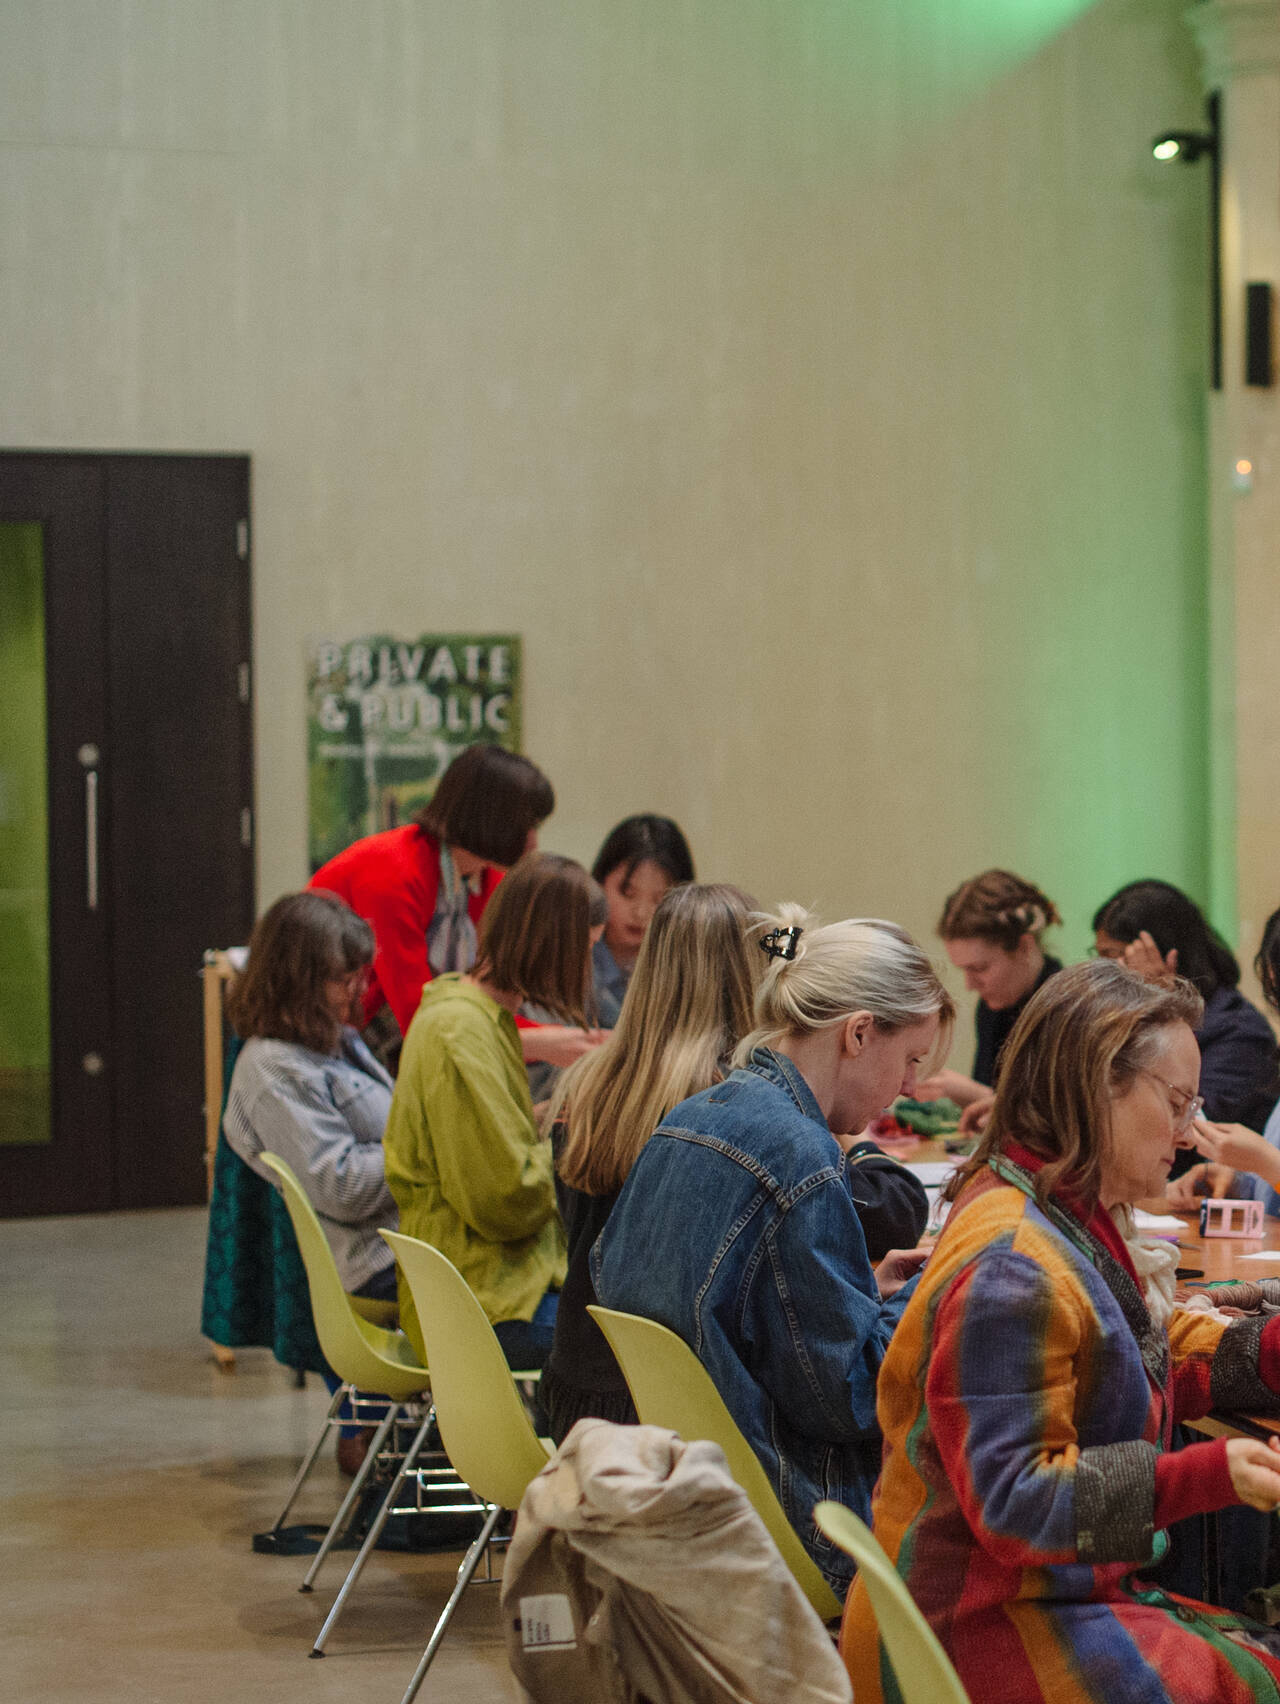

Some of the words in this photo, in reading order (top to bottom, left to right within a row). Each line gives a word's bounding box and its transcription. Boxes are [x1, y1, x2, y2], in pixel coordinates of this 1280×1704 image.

[317, 644, 510, 684] PRIVATE
[319, 694, 349, 733] &
[362, 693, 510, 733] PUBLIC
